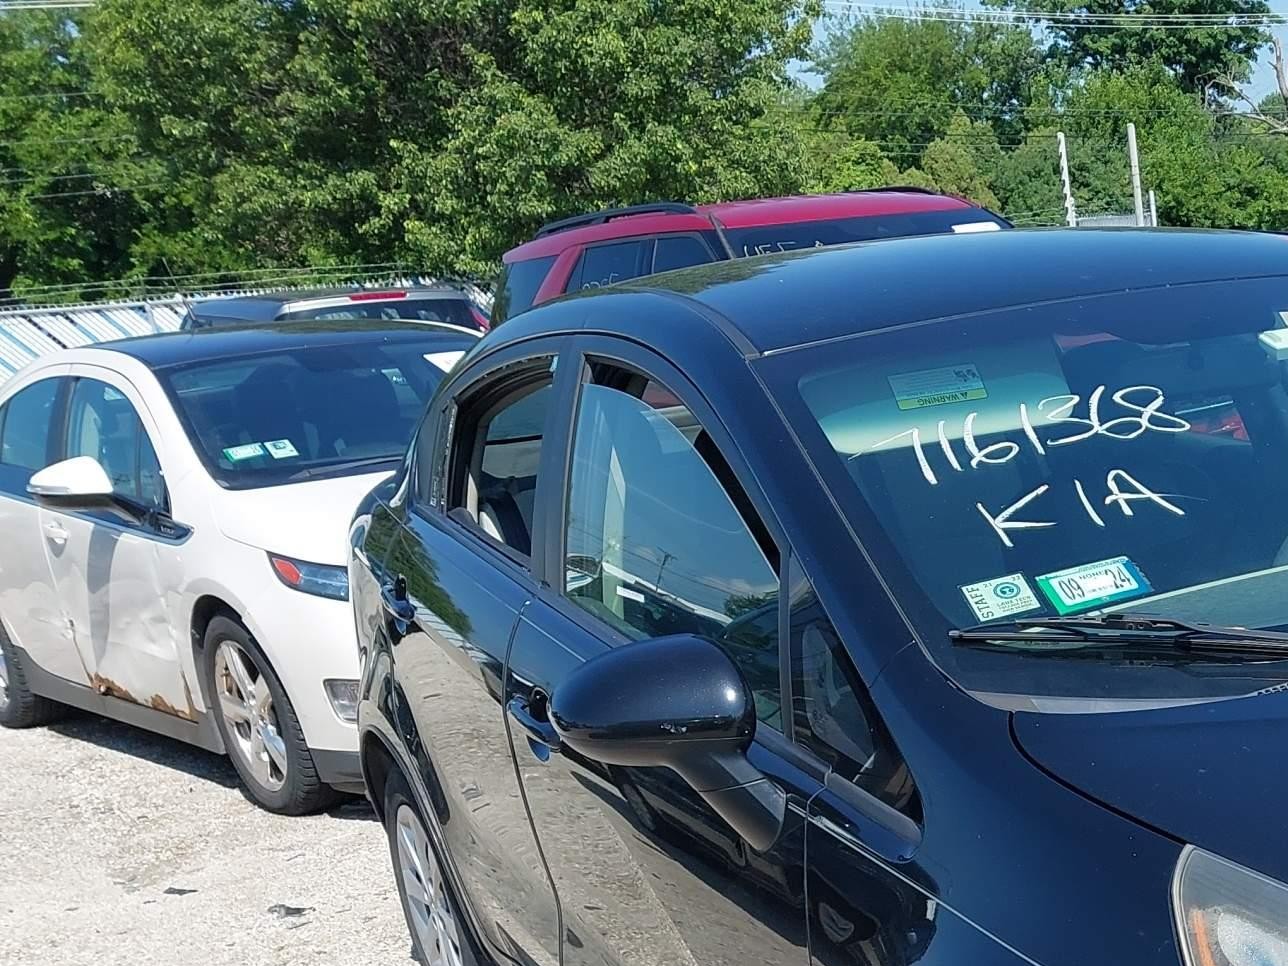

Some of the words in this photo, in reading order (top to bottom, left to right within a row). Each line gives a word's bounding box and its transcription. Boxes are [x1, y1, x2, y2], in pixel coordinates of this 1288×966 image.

[917, 393, 959, 406] WARNING
[872, 385, 1191, 485] 7161368
[976, 469, 1188, 547] KIA
[1058, 577, 1086, 601] 09
[1104, 566, 1132, 589] 24
[966, 586, 995, 620] STAFF
